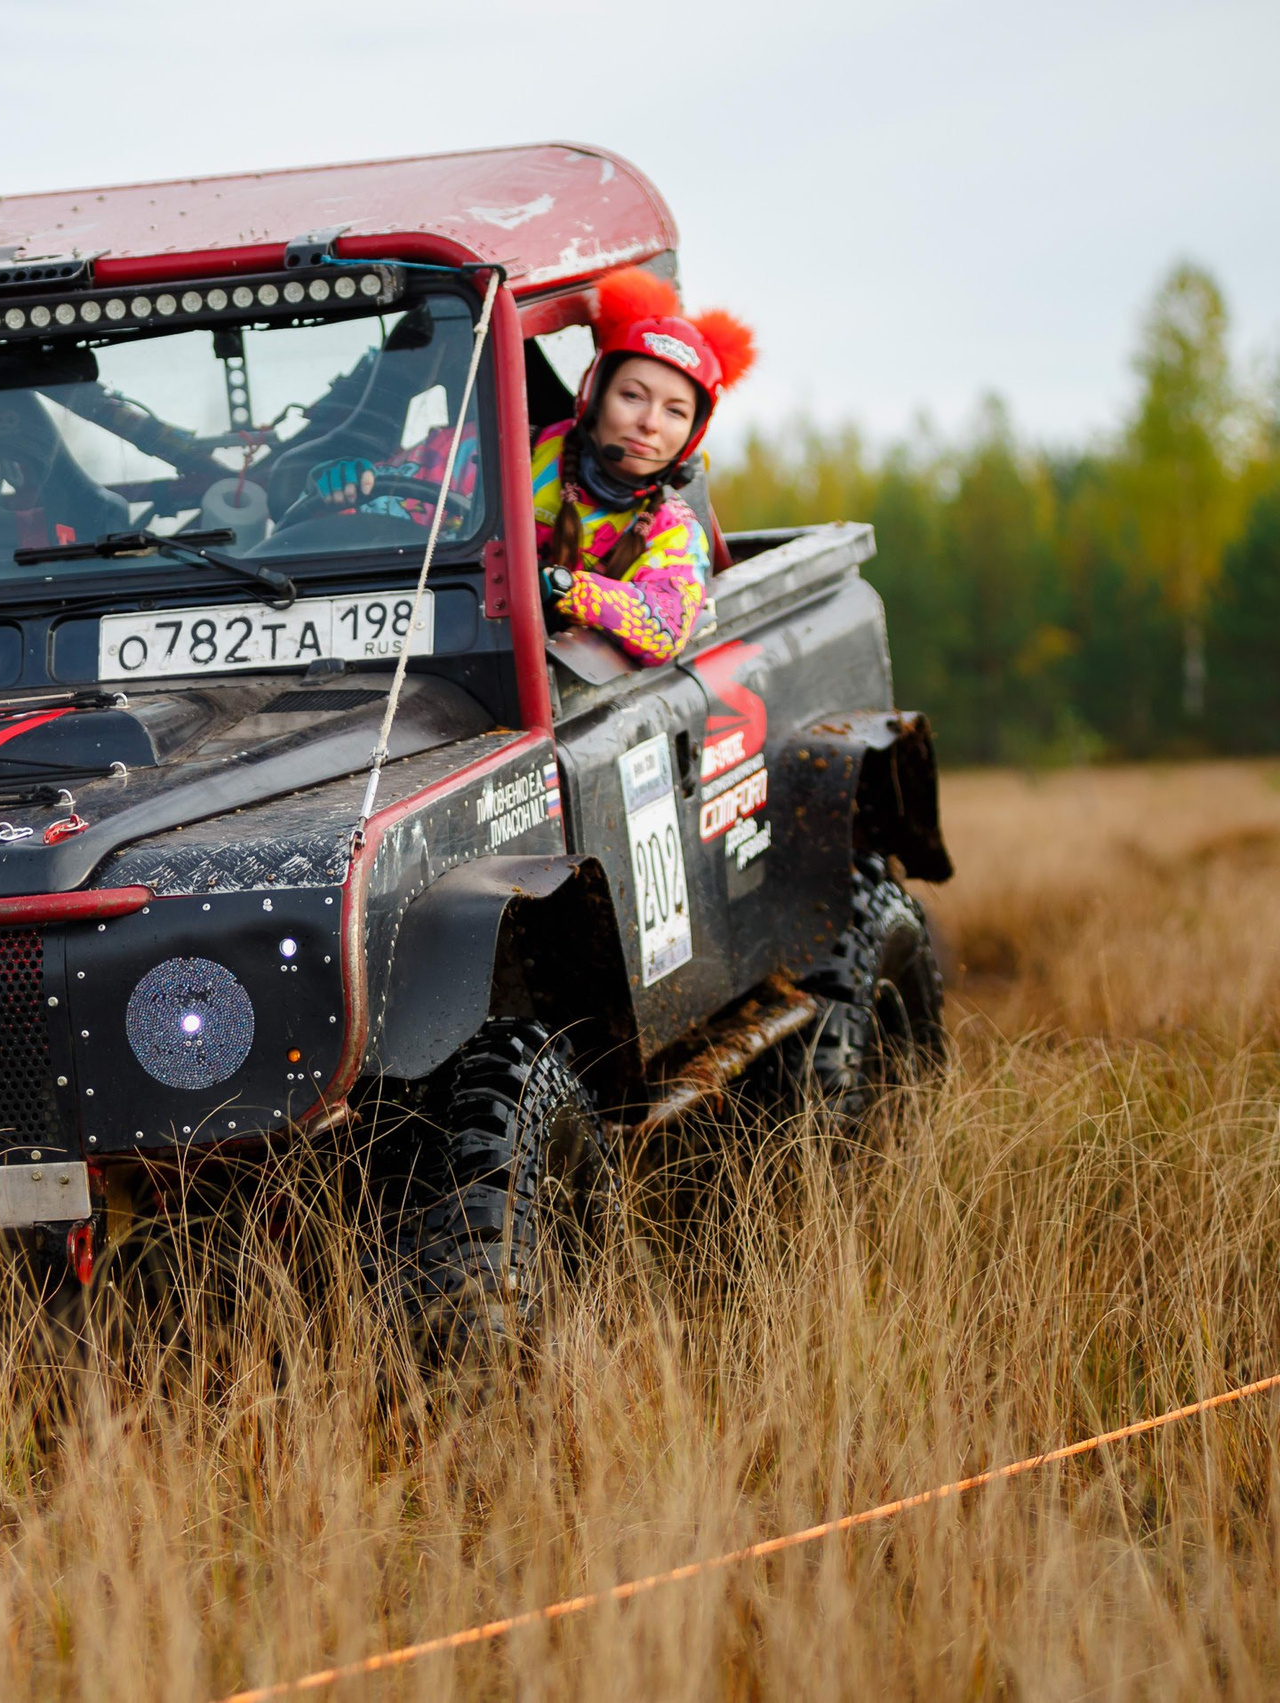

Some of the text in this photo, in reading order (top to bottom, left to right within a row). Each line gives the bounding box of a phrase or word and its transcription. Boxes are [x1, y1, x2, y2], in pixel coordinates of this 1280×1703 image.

[339, 599, 413, 641] 198
[364, 641, 403, 656] RUS
[490, 802, 532, 849] ЛУКАСОН
[700, 767, 768, 839] COMFORT
[636, 824, 683, 932] 202
